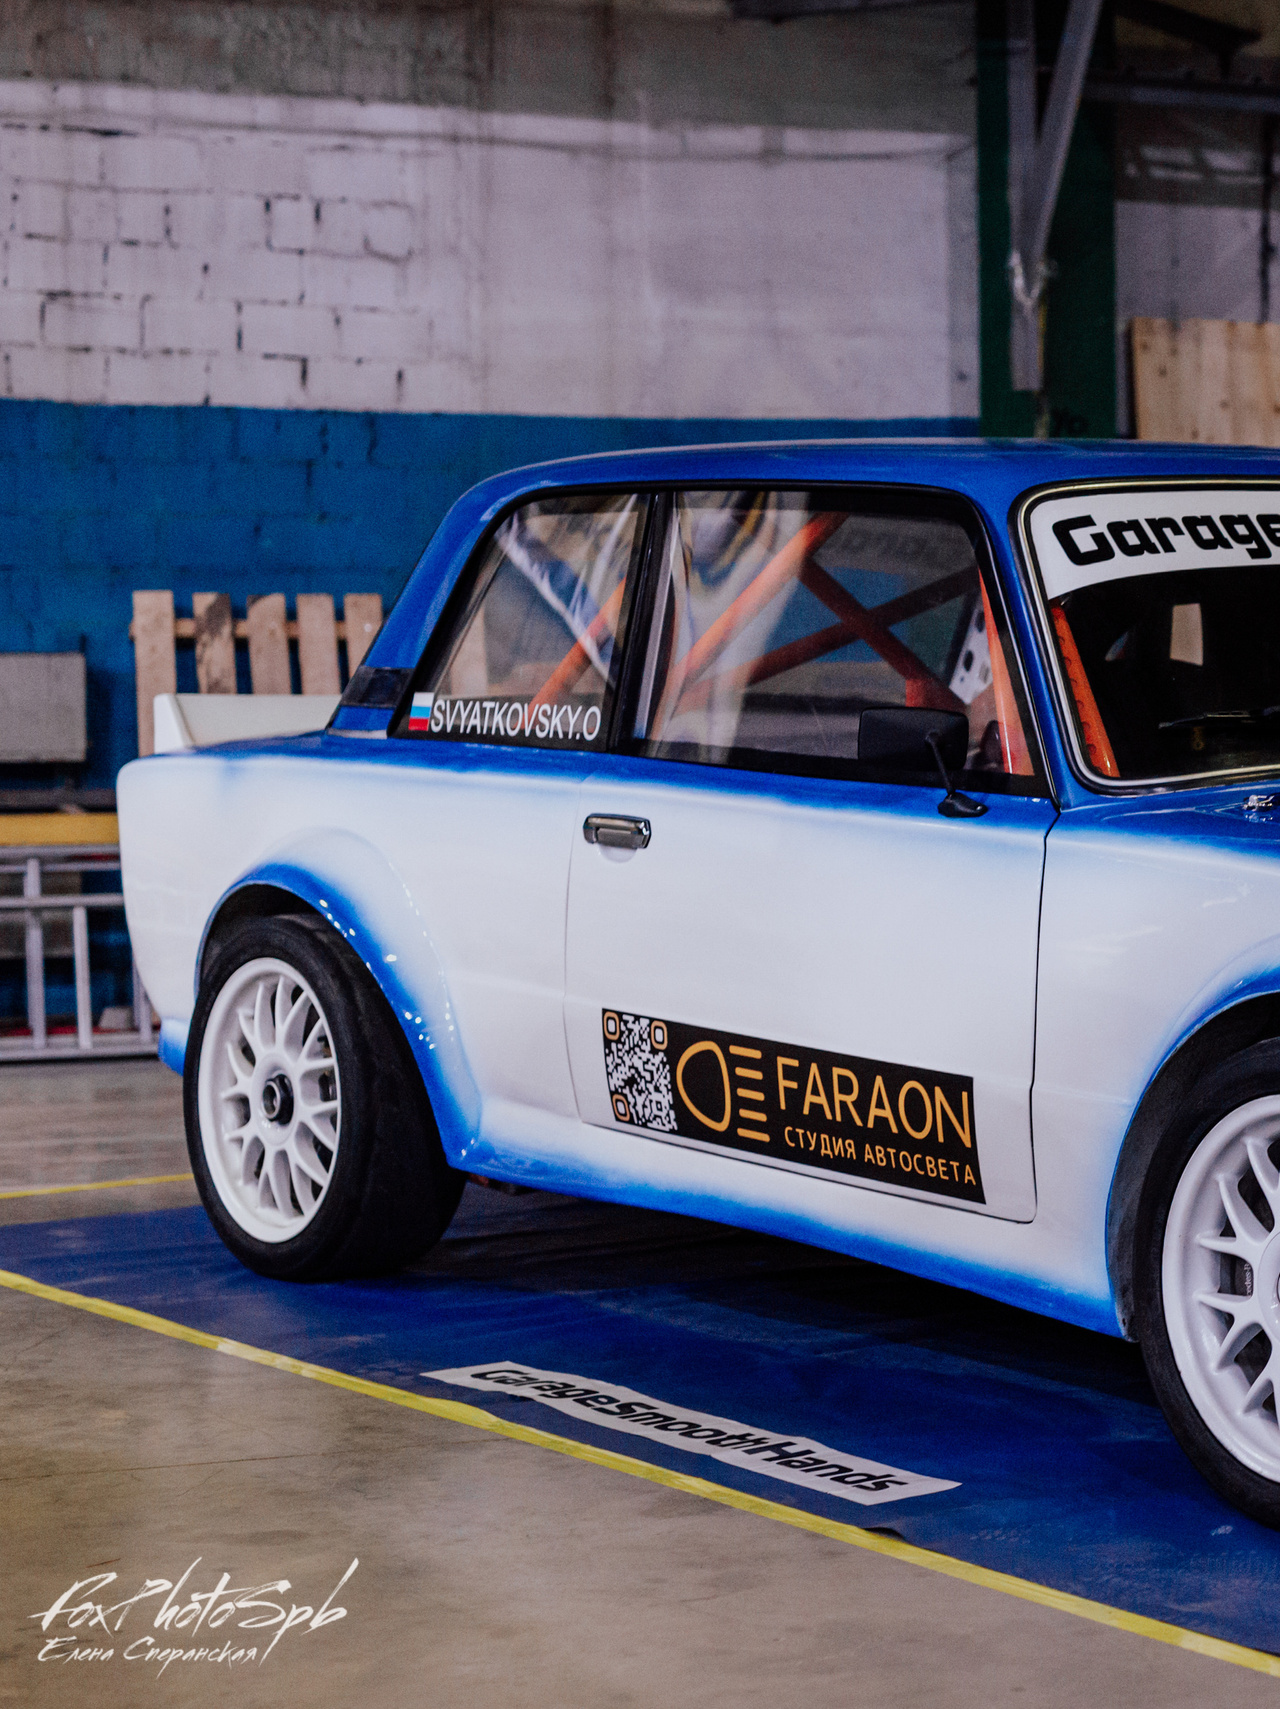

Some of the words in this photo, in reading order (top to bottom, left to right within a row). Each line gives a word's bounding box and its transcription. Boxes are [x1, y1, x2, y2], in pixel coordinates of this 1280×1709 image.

[430, 699, 602, 742] SVYATKOVSKY.O
[776, 1055, 973, 1149] FARAON
[784, 1125, 857, 1161] СТУДИЯ
[864, 1143, 978, 1187] АВТОСВЕТА
[470, 1369, 909, 1493] GarageSmoothHands
